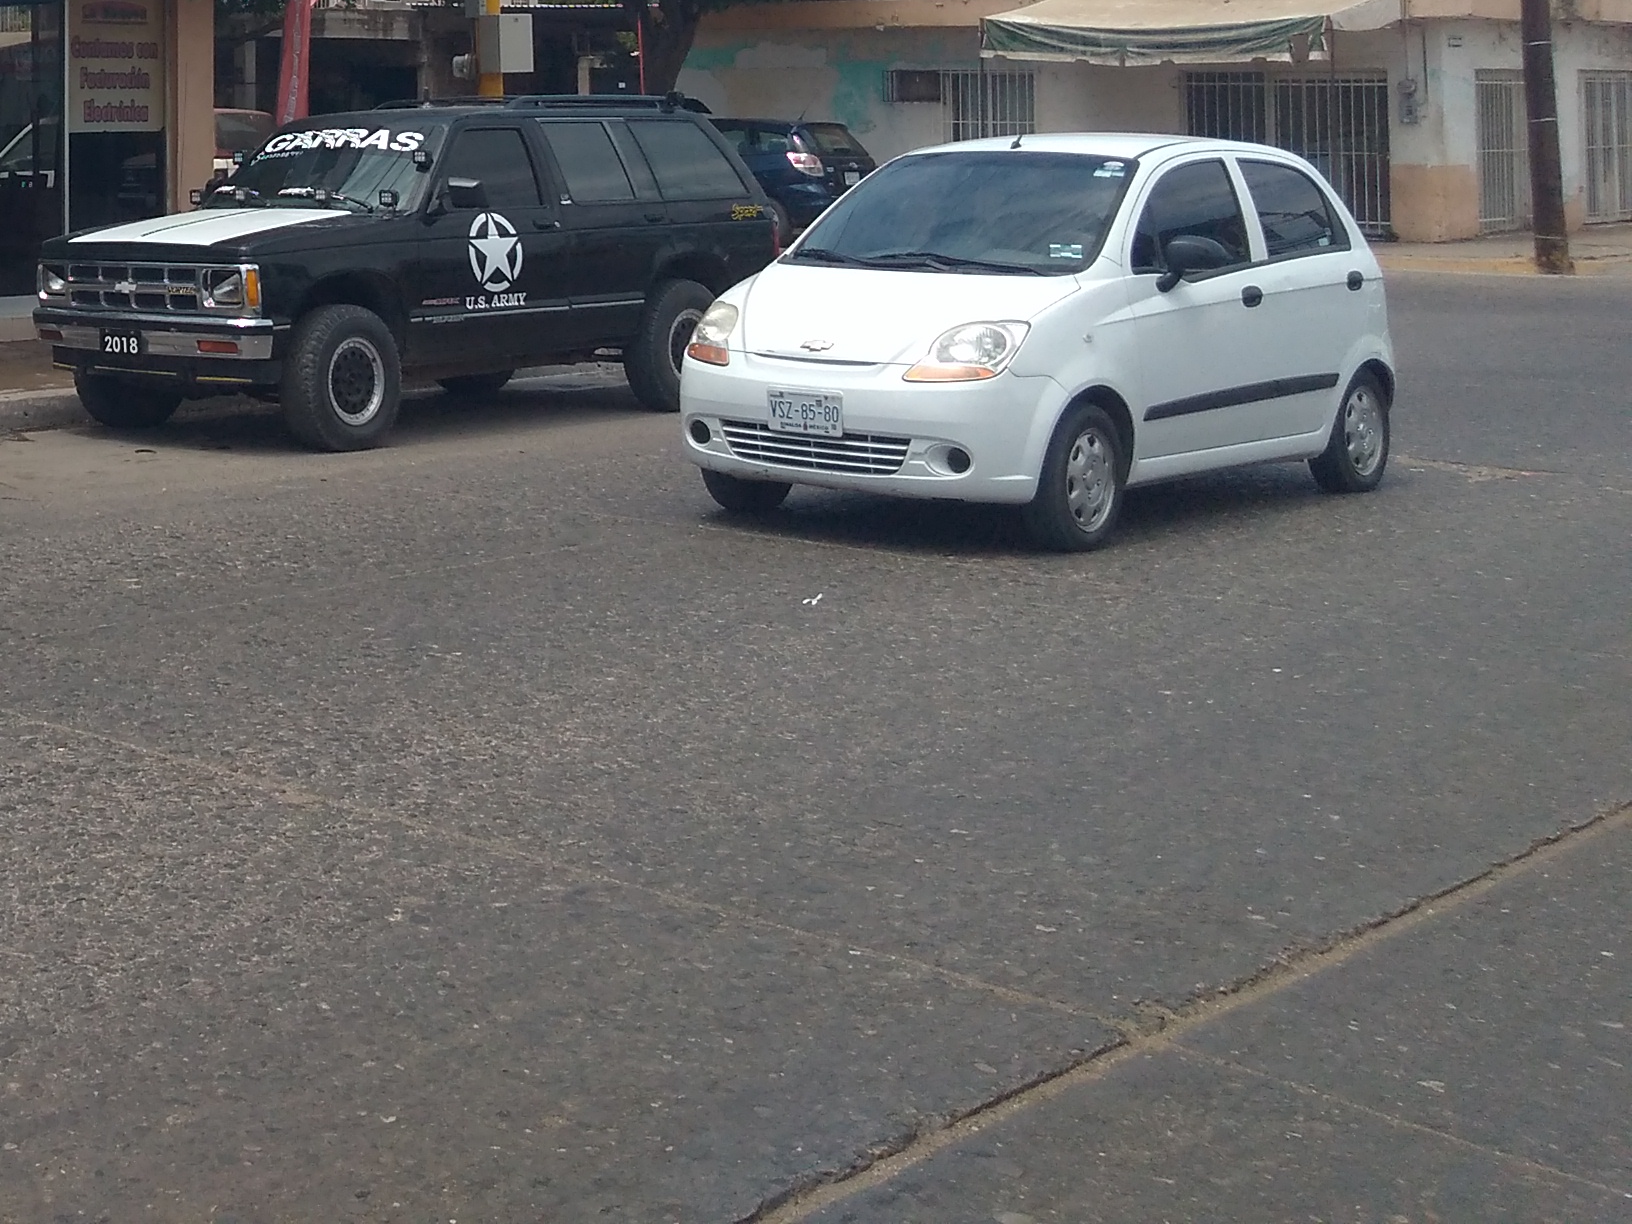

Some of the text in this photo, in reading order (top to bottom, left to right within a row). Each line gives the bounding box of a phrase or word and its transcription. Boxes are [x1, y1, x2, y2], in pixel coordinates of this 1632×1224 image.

[80, 66, 150, 90] Facturación
[83, 98, 149, 123] Electrónica
[264, 128, 425, 153] GARRAS
[465, 296, 490, 309] U.S.
[491, 292, 527, 307] ARMY
[104, 335, 138, 354] 2018
[770, 399, 839, 423] VSZ-85-80
